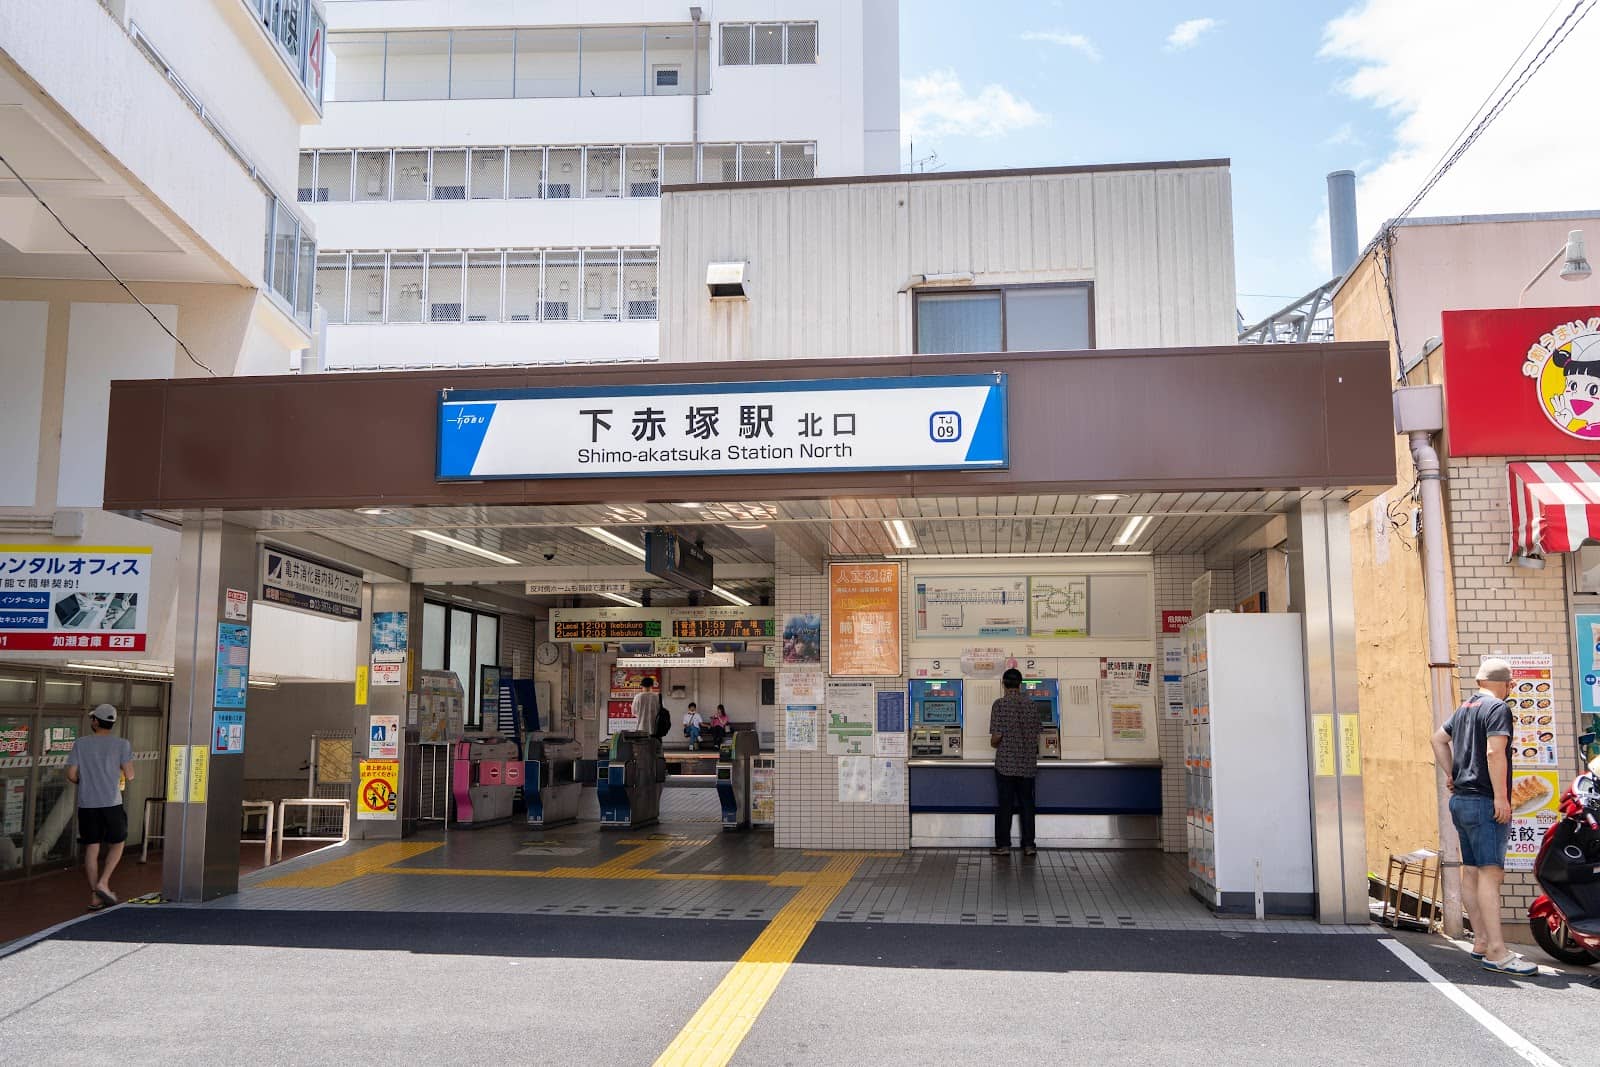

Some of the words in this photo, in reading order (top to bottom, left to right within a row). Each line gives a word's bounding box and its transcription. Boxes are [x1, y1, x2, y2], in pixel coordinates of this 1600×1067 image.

[579, 404, 774, 442] 下赤塚駅
[798, 413, 856, 437] 北口
[938, 416, 953, 424] TJ
[937, 426, 954, 438] 09
[578, 447, 721, 464] Shimo-akatsuka
[727, 444, 793, 460] Station
[800, 443, 852, 459] North
[0, 579, 80, 589] 能で簡単契約!
[554, 610, 560, 618] 2
[556, 630, 562, 638] 2
[114, 637, 130, 646] 2F
[933, 660, 941, 670] 3
[1027, 660, 1035, 670] 2
[1515, 843, 1535, 853] 260
